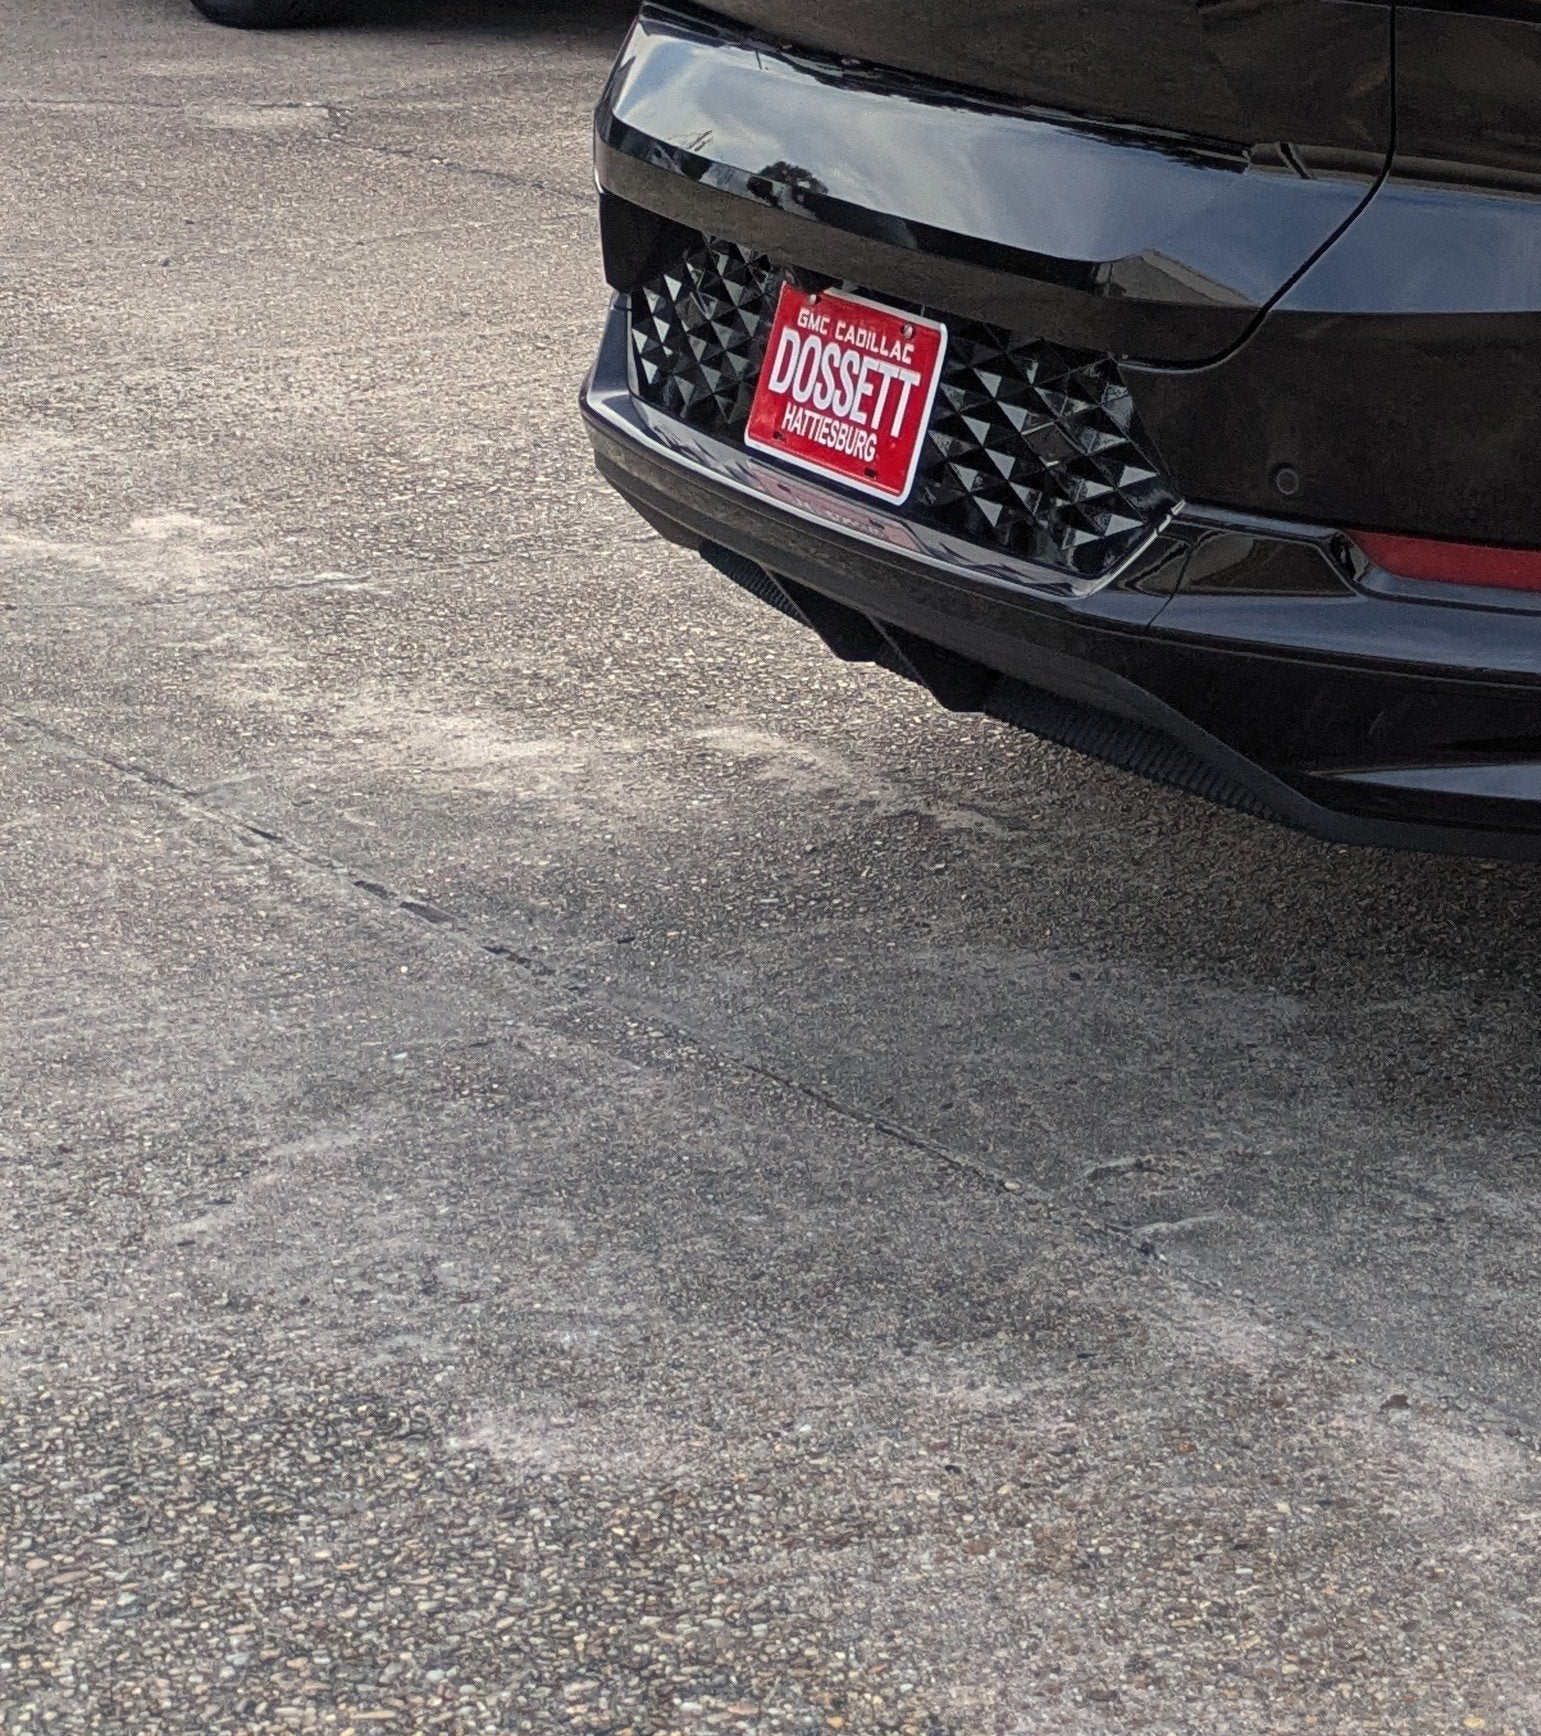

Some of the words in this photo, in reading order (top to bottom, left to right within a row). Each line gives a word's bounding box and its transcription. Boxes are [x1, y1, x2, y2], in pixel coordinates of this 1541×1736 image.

[797, 307, 830, 335] GMC
[834, 319, 915, 364] CADILLAC
[768, 326, 921, 438] DOSSETT
[781, 402, 878, 462] HATTIESBURG
